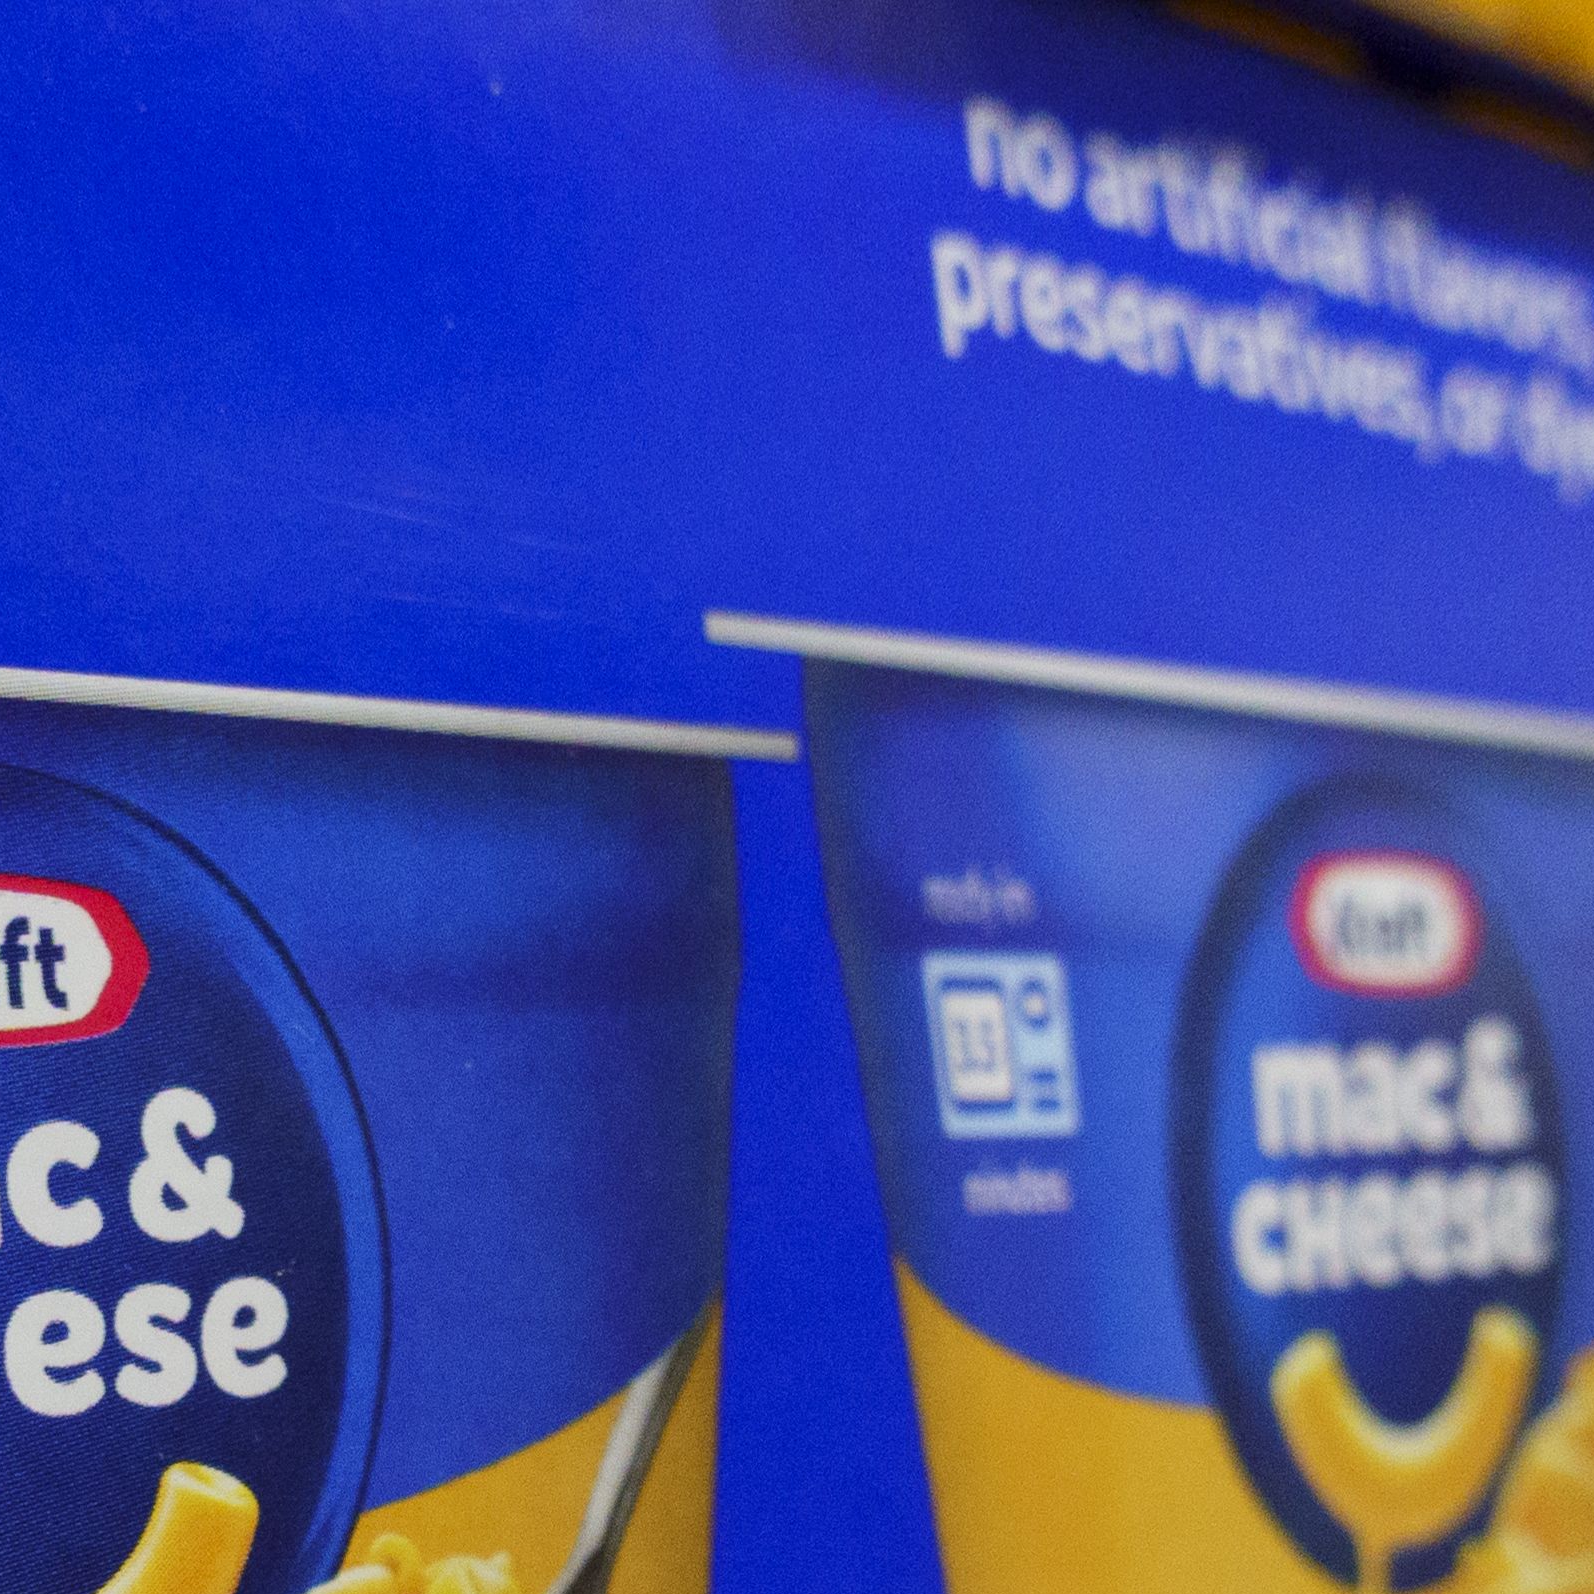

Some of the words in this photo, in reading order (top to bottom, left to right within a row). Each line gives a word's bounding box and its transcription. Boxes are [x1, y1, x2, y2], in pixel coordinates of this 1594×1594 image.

[964, 94, 1076, 212] no
[1251, 1039, 1457, 1159] mac
[128, 1086, 245, 1242] &
